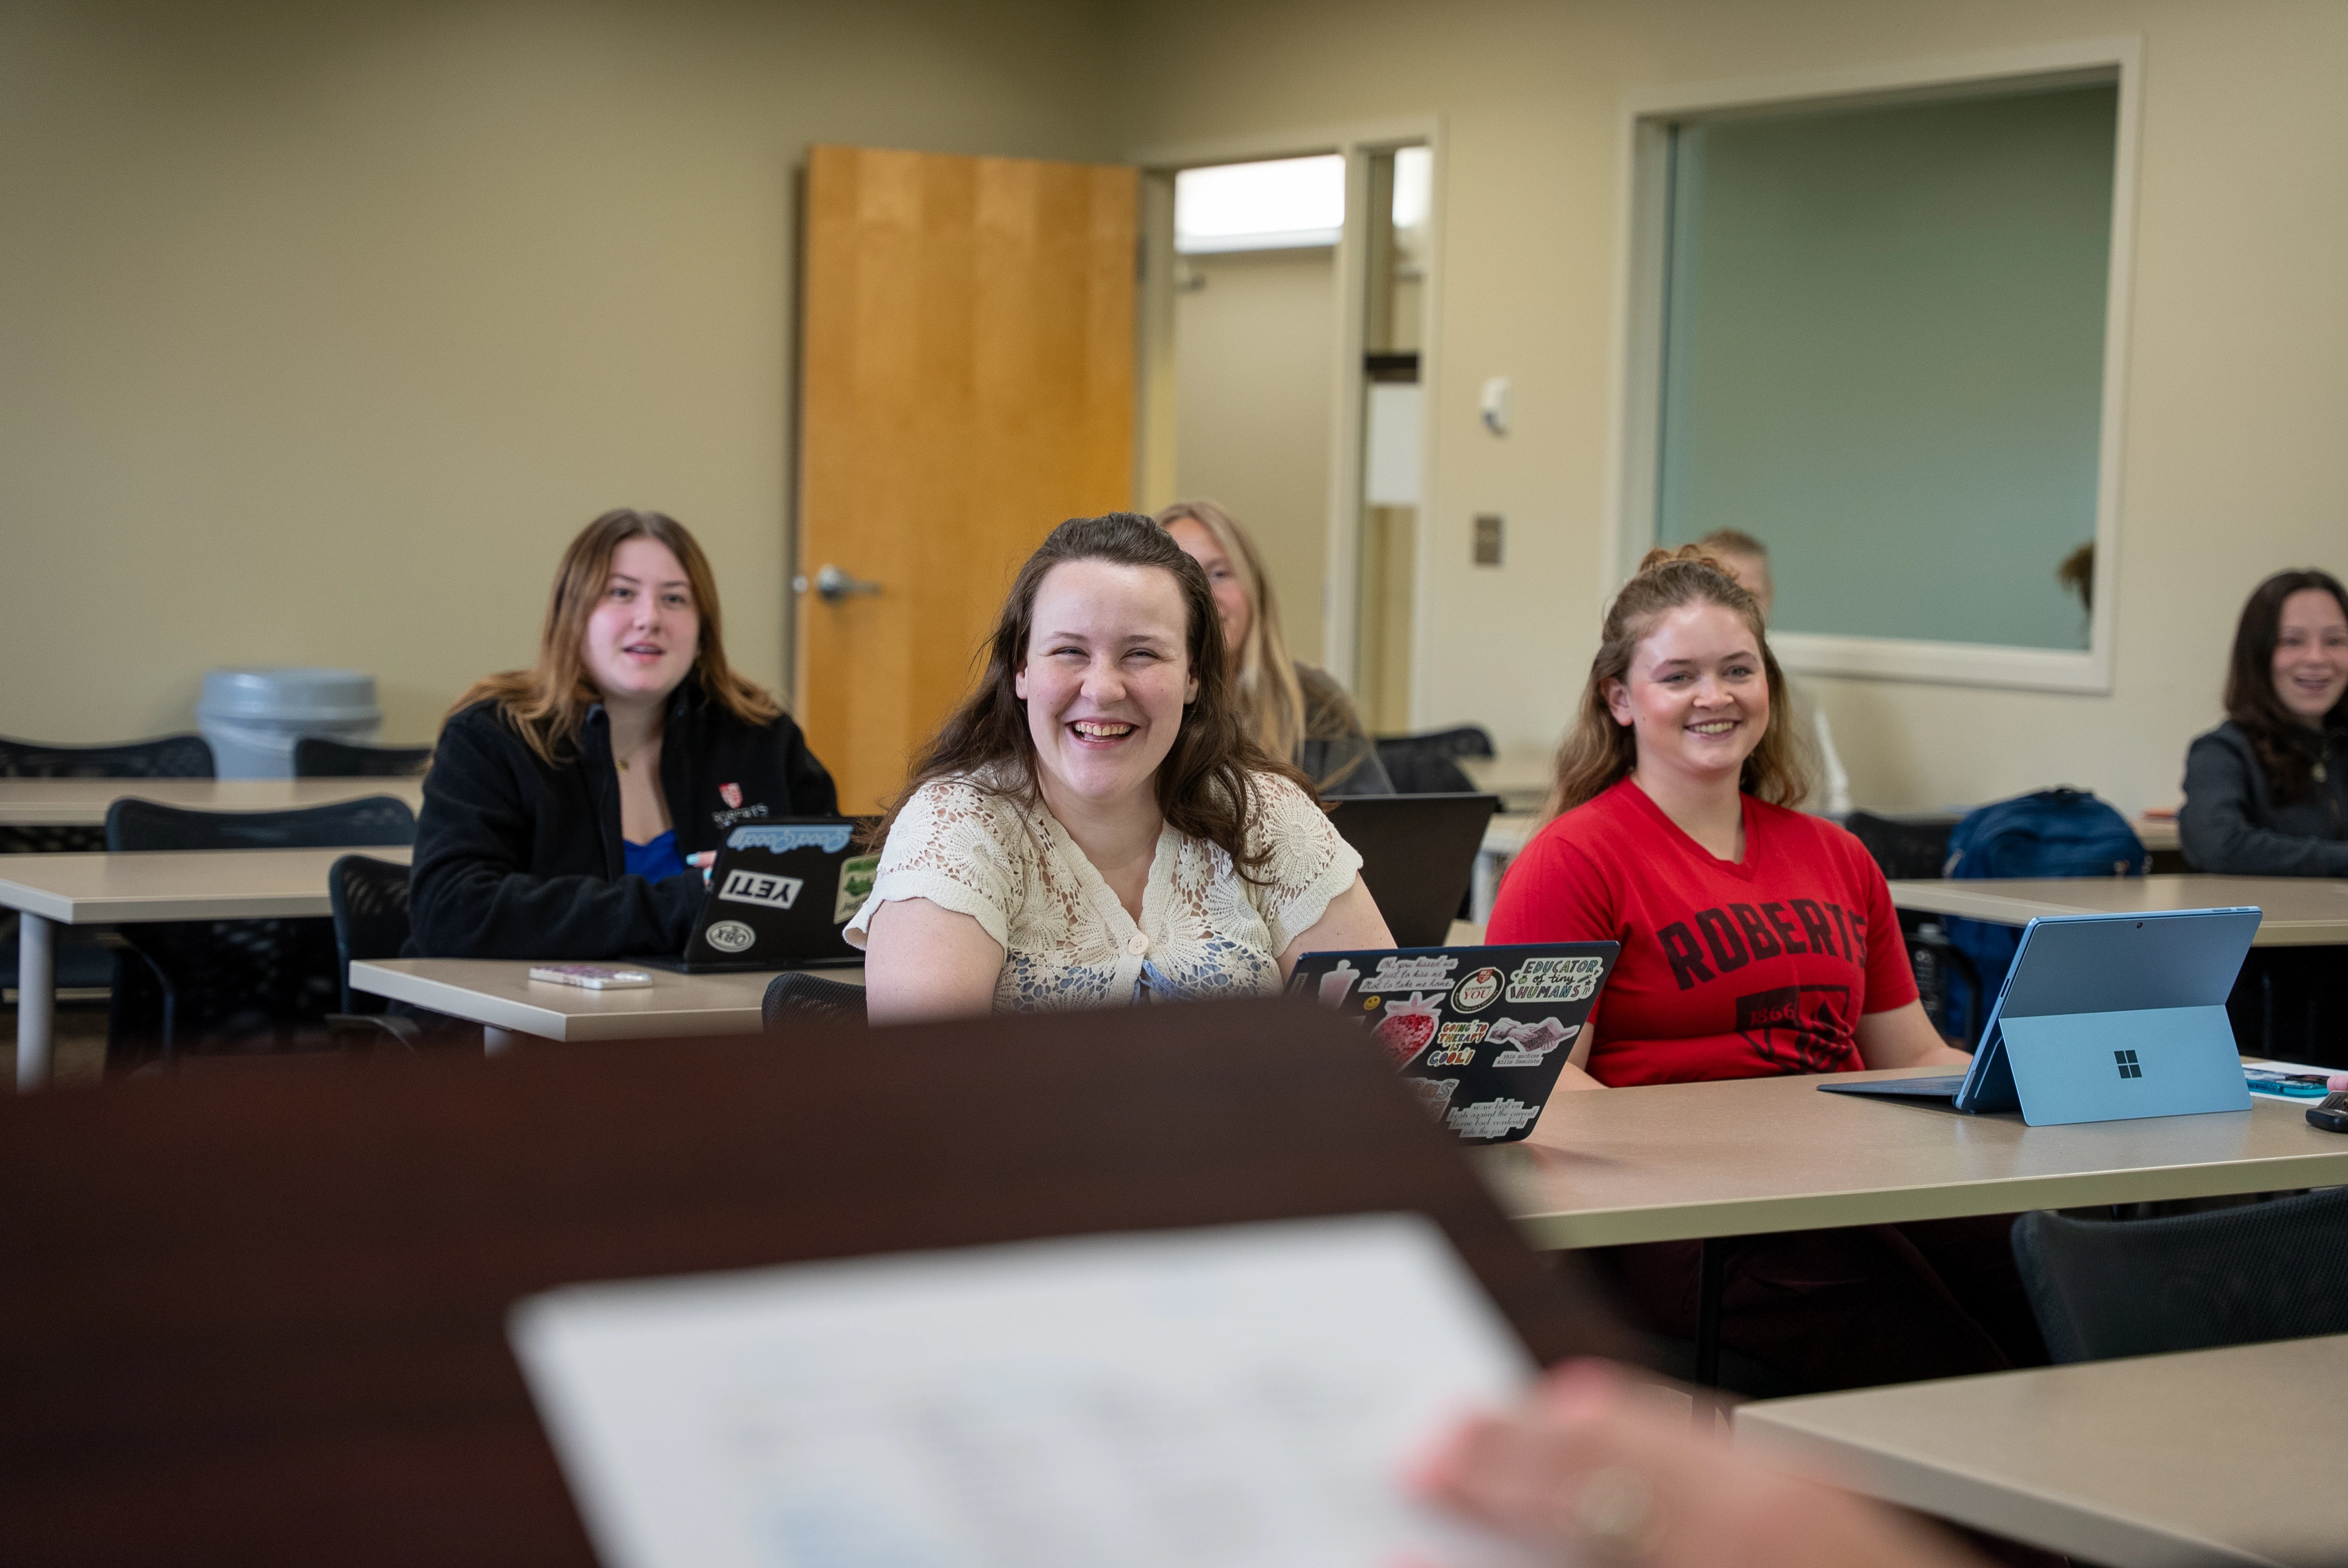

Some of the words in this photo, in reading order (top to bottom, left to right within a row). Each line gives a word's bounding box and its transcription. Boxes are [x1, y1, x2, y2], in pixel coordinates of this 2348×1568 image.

[728, 876, 790, 901] YETI
[1657, 899, 1867, 991] ROBERTS
[1415, 958, 1443, 968] kissed
[1523, 960, 1599, 974] EDUCATOR
[1378, 970, 1399, 981] just
[1401, 970, 1410, 978] to
[1413, 969, 1428, 978] kiss
[1532, 973, 1547, 986] of
[1548, 973, 1575, 985] tiny
[1394, 980, 1413, 988] take
[1464, 989, 1491, 1000] YOU
[1516, 985, 1581, 999] HUMANS
[1750, 1003, 1796, 1026] 1866
[1443, 1024, 1471, 1033] GOING
[1475, 1024, 1487, 1033] TO
[1439, 1033, 1485, 1043] THERAPY
[1449, 1043, 1461, 1051] IS
[1471, 1110, 1496, 1119] against
[1498, 1108, 1508, 1117] the
[1475, 1116, 1491, 1126] back
[1479, 1126, 1489, 1134] the
[1491, 1127, 1507, 1136] past
